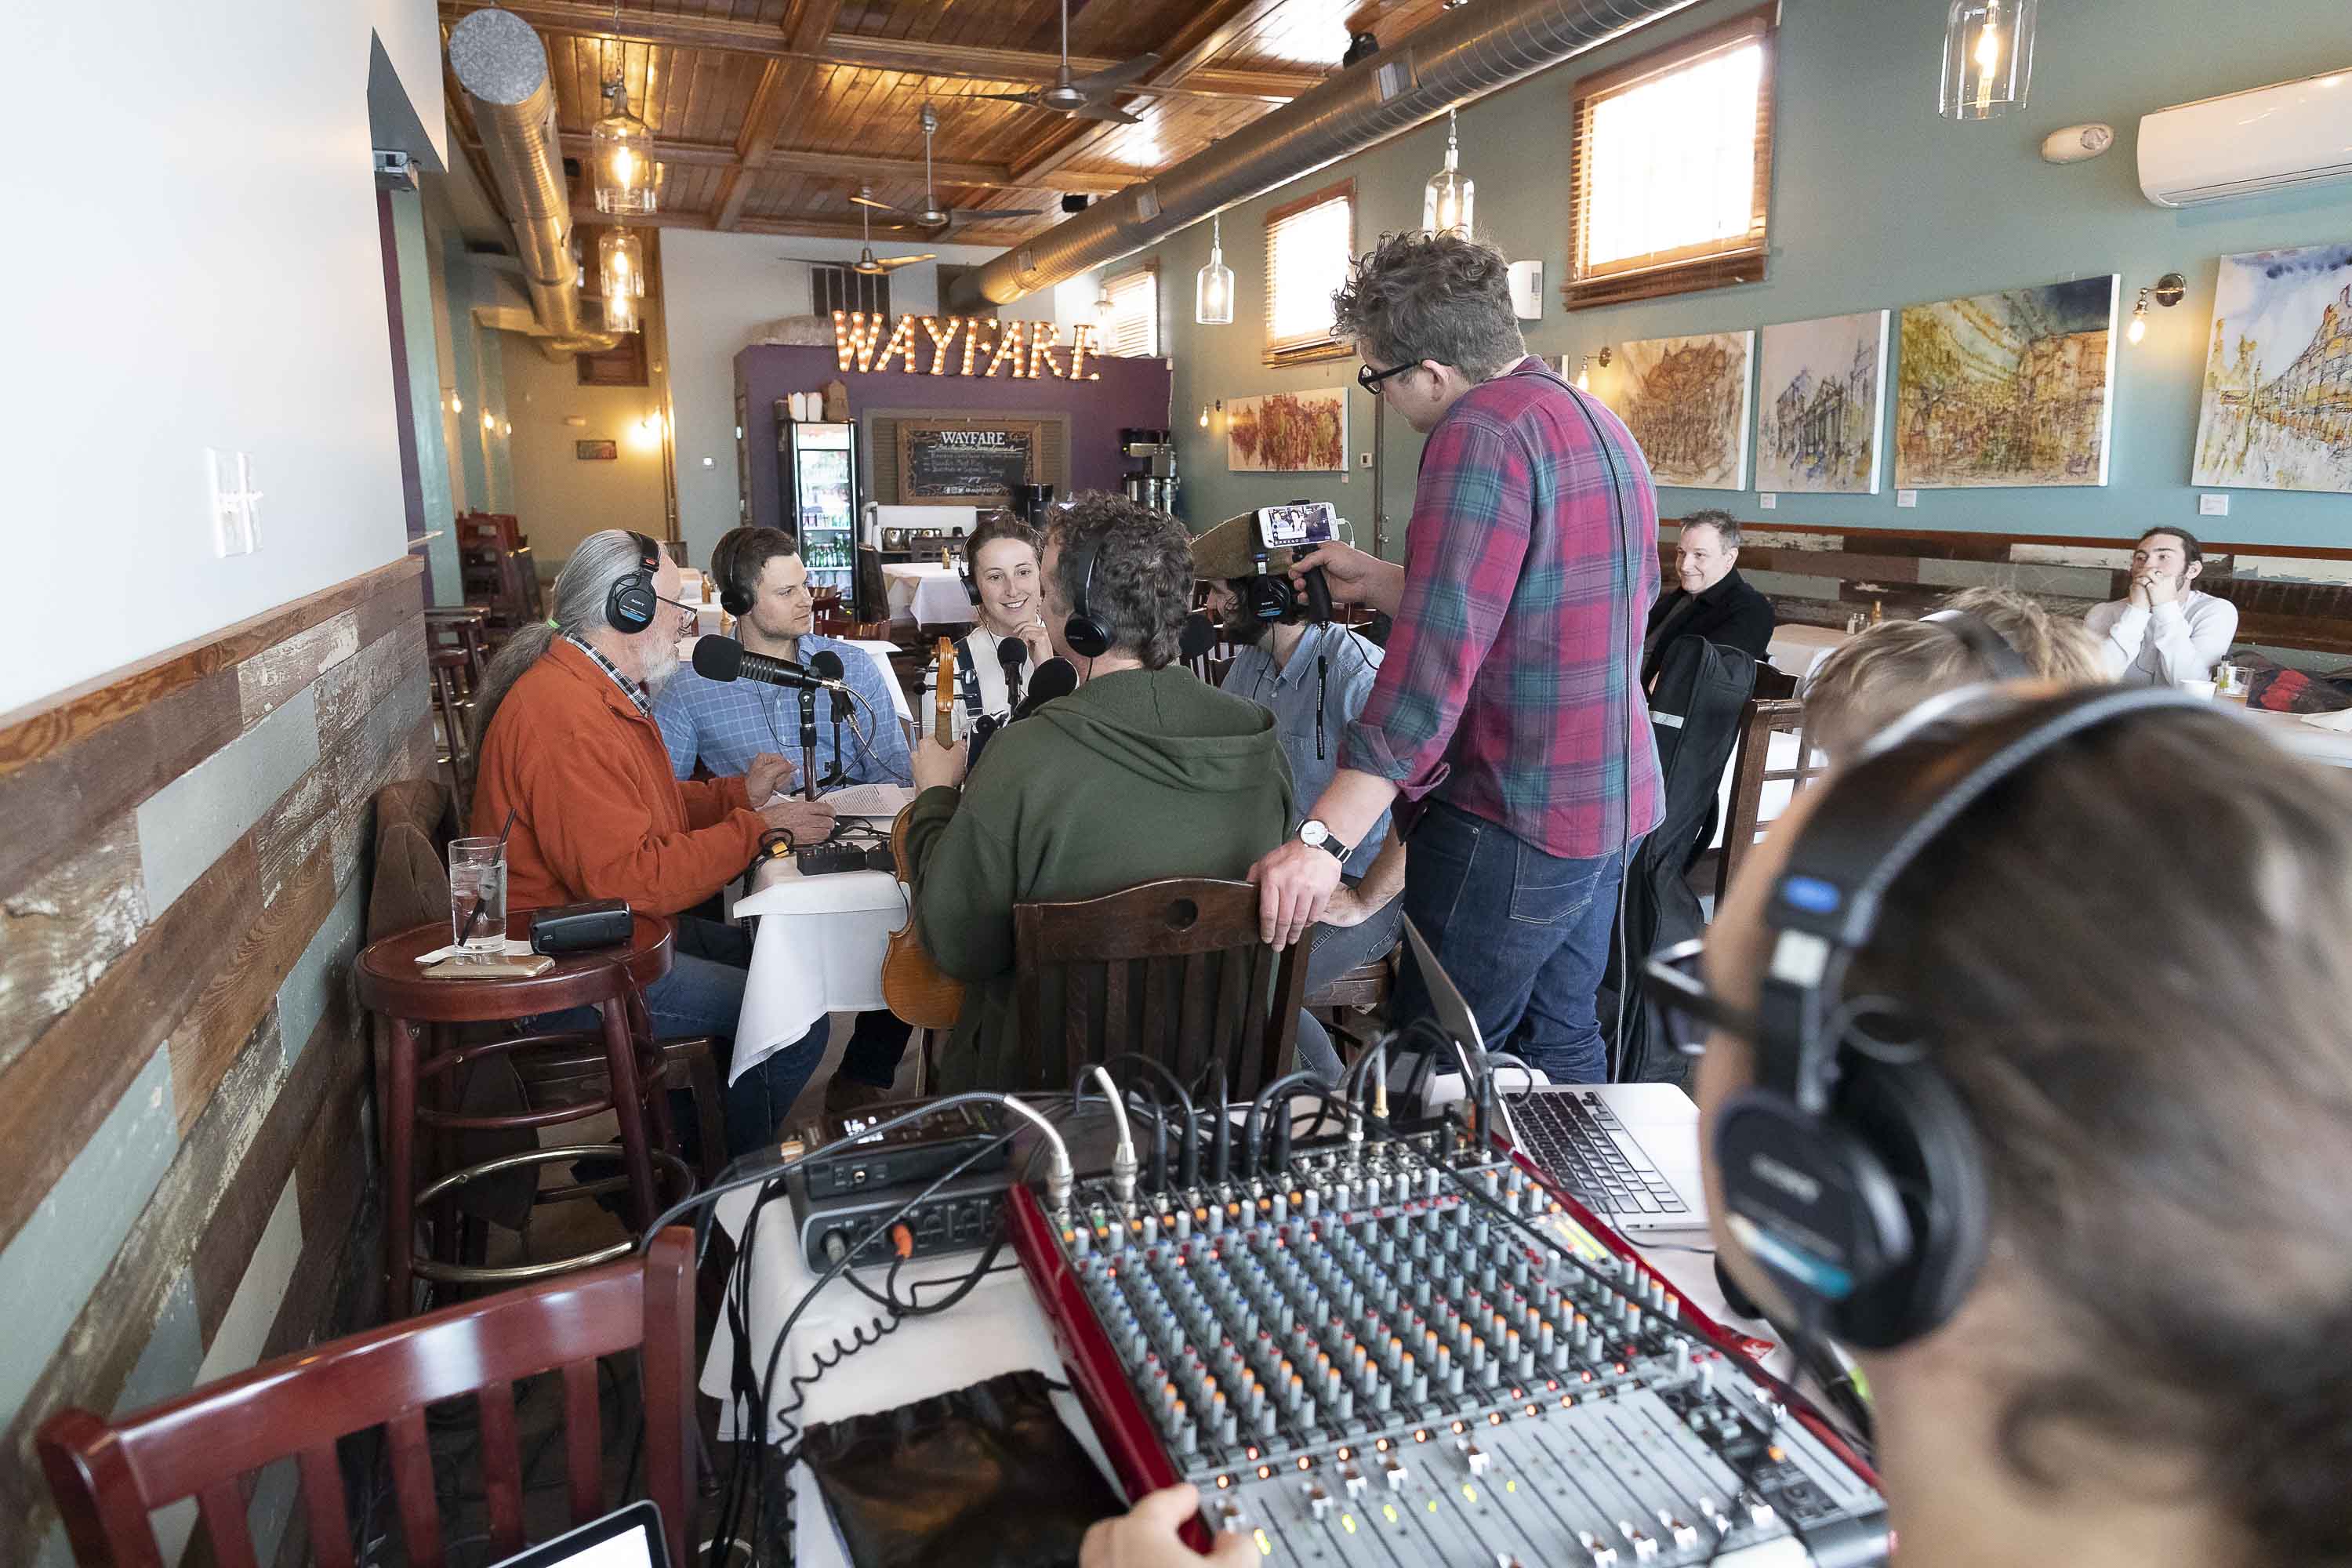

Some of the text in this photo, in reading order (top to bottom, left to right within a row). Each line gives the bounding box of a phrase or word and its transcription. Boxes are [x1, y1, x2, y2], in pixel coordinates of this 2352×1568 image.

[833, 310, 1100, 380] WAYFARE
[940, 431, 1005, 445] WAYFARE
[630, 598, 645, 607] SONY
